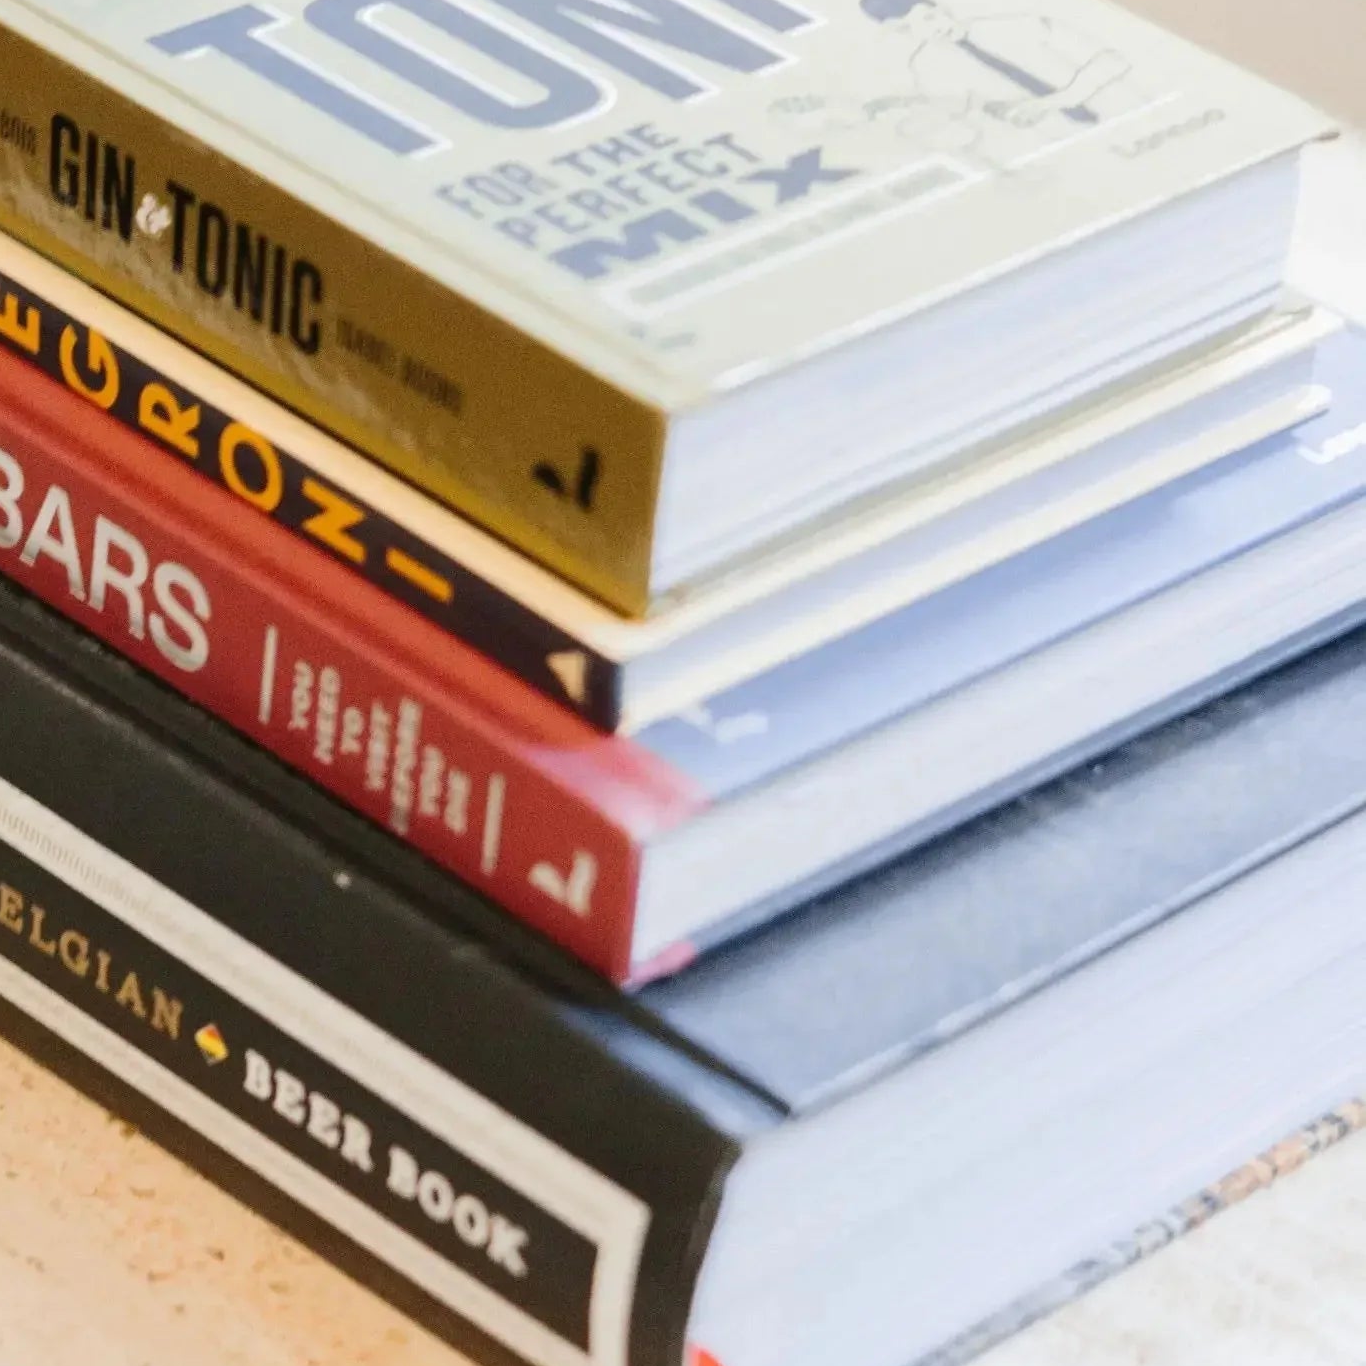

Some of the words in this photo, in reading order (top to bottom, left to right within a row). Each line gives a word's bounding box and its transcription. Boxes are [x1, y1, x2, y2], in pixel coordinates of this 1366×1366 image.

[49, 112, 134, 247] GIN
[134, 192, 171, 237] &
[165, 179, 324, 358] TONIC
[434, 161, 558, 220] FOR
[551, 122, 680, 177] THE
[493, 132, 763, 251] PERFECT
[548, 146, 866, 281] MIX
[243, 1047, 374, 1171] BEER
[387, 1143, 530, 1278] BOOK
